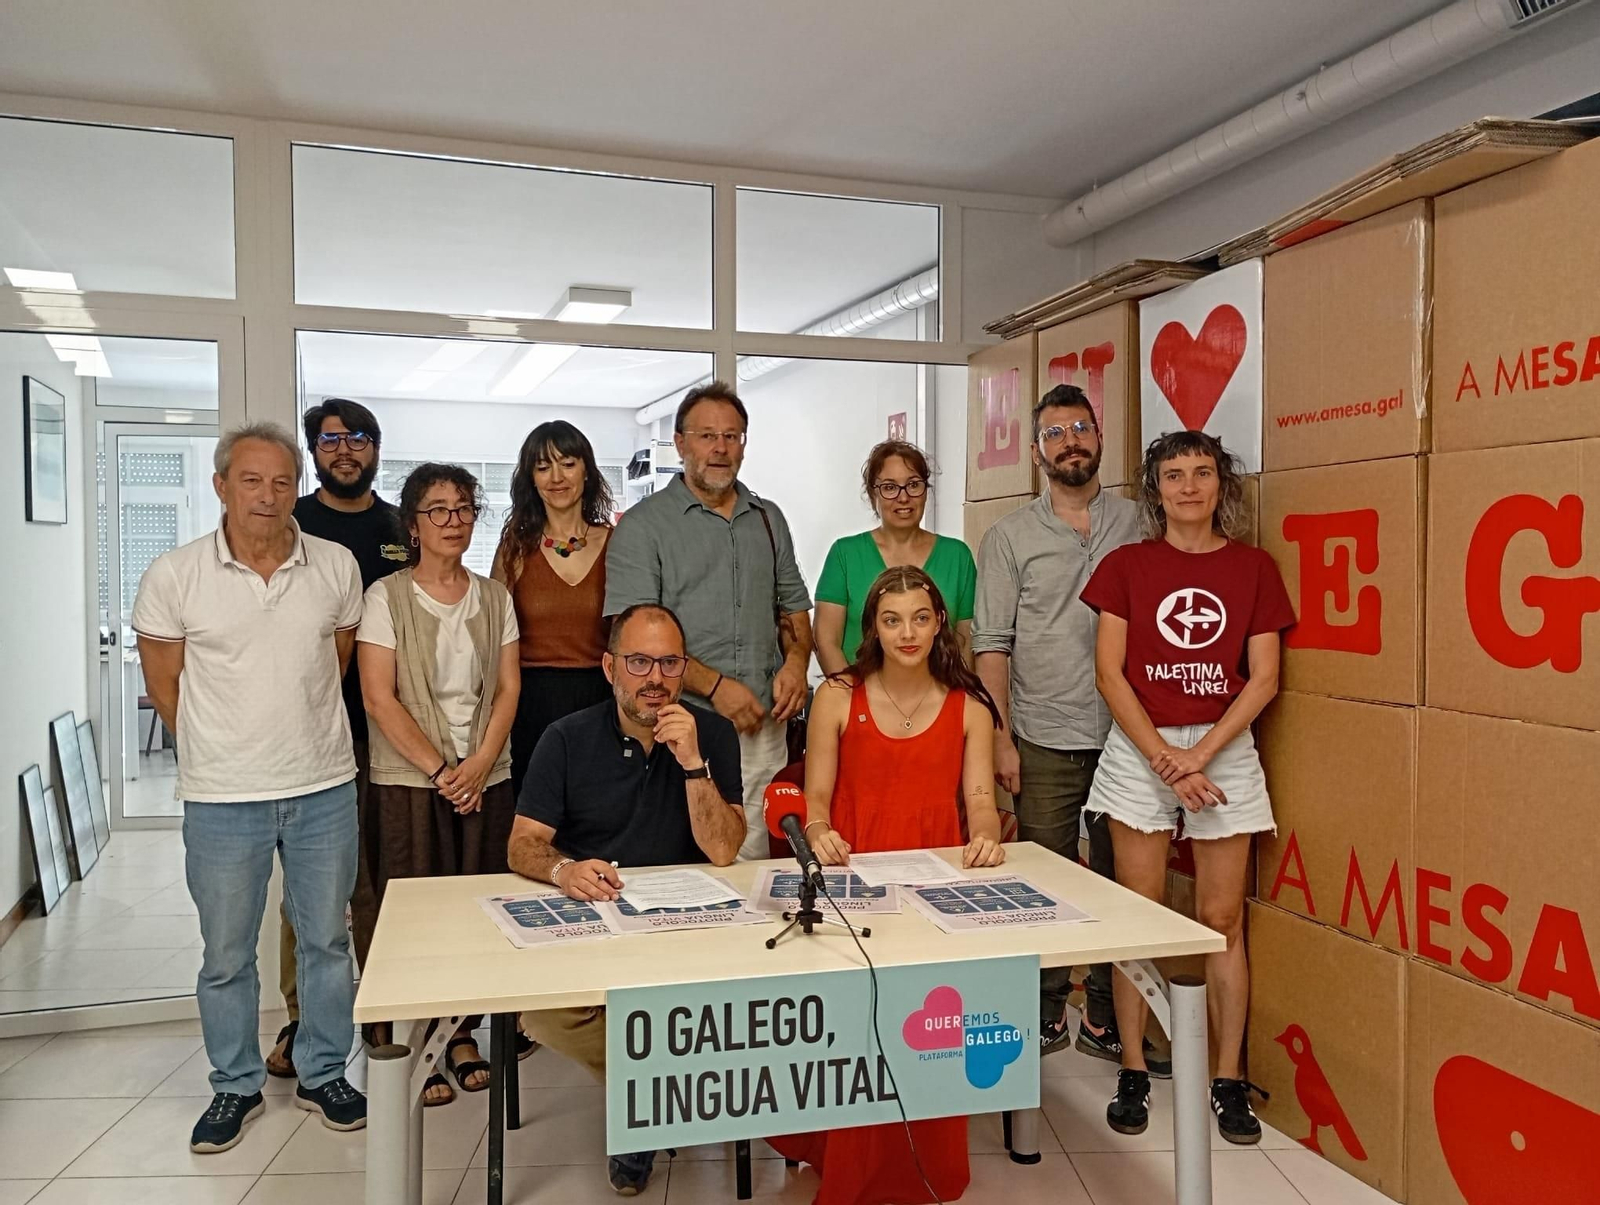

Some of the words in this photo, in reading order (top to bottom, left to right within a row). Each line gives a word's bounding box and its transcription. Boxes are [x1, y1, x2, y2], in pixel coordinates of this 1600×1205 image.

[1455, 361, 1482, 402] A
[1276, 389, 1404, 429] www.amesa.gal
[1145, 663, 1224, 682] PALESTINA
[775, 787, 801, 797] rne
[979, 915, 1057, 926] PROTOCOLO
[1270, 829, 1317, 917] A
[1341, 846, 1600, 1022] MESA
[626, 1010, 652, 1059] O
[667, 994, 836, 1055] GALEGO,
[924, 1012, 1000, 1032] QUEREMOS
[919, 1050, 963, 1061] PLATAFORMA
[627, 1069, 779, 1129] LINGUA
[789, 1055, 897, 1112] VITAL
